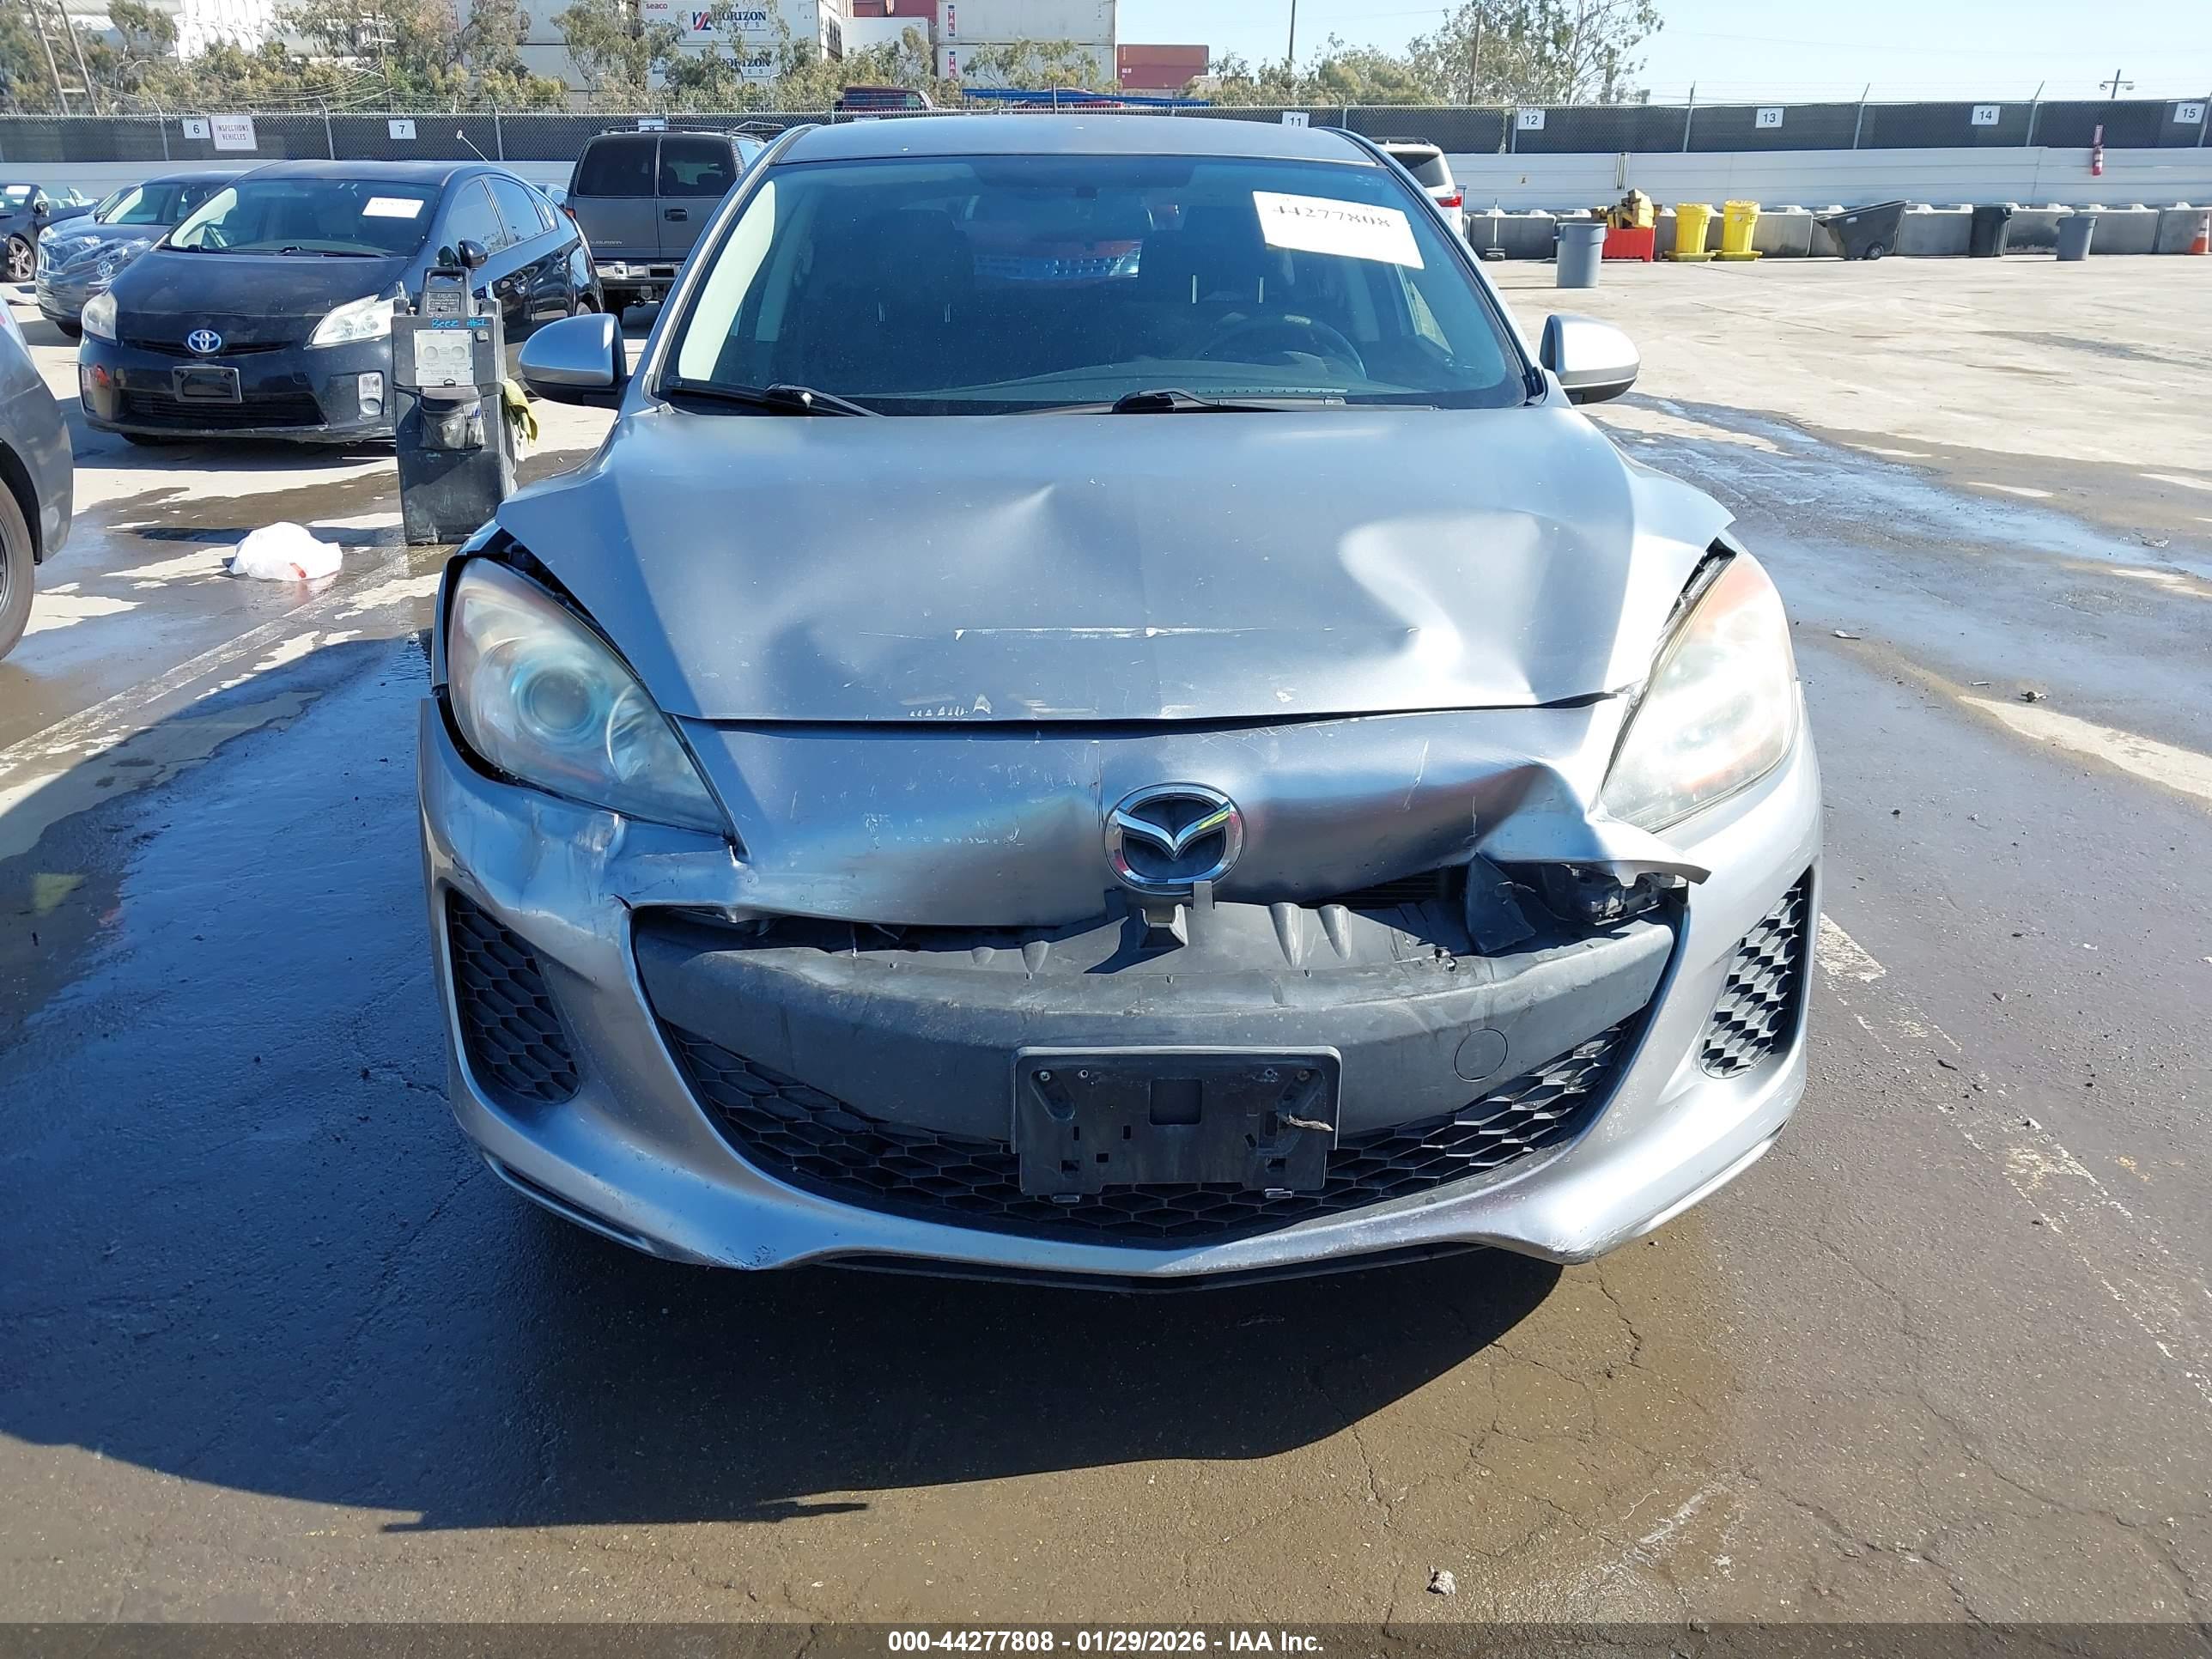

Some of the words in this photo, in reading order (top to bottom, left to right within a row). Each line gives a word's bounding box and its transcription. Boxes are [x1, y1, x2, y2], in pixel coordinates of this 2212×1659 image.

[722, 58, 771, 67] ORIZON
[1763, 112, 1776, 123] 13
[1979, 110, 1992, 120] 14
[2183, 108, 2197, 118] 15
[1290, 116, 1301, 127] 11
[1525, 115, 1538, 125] 12
[192, 124, 200, 134] 6
[216, 124, 249, 132] INSPECTIONS
[398, 125, 405, 135] 7
[1273, 204, 1391, 228] 44277808
